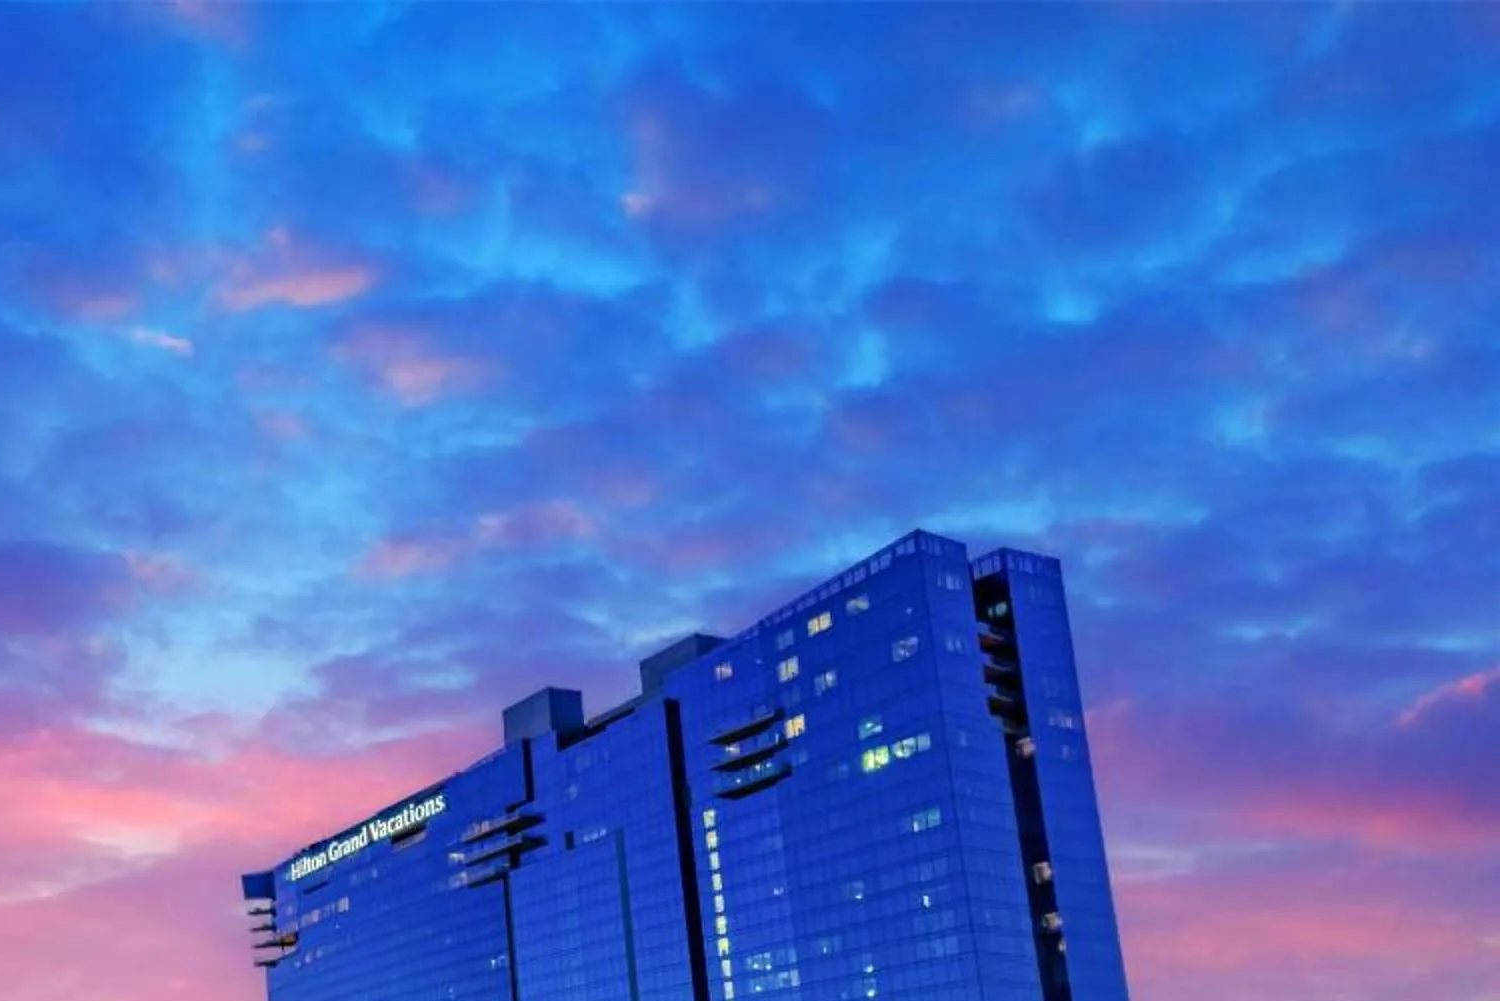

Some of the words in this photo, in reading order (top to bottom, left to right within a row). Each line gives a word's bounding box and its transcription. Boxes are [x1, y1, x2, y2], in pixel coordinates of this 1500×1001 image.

[291, 850, 327, 881] Hilton
[328, 827, 367, 861] Grand
[369, 795, 445, 841] Vacations
